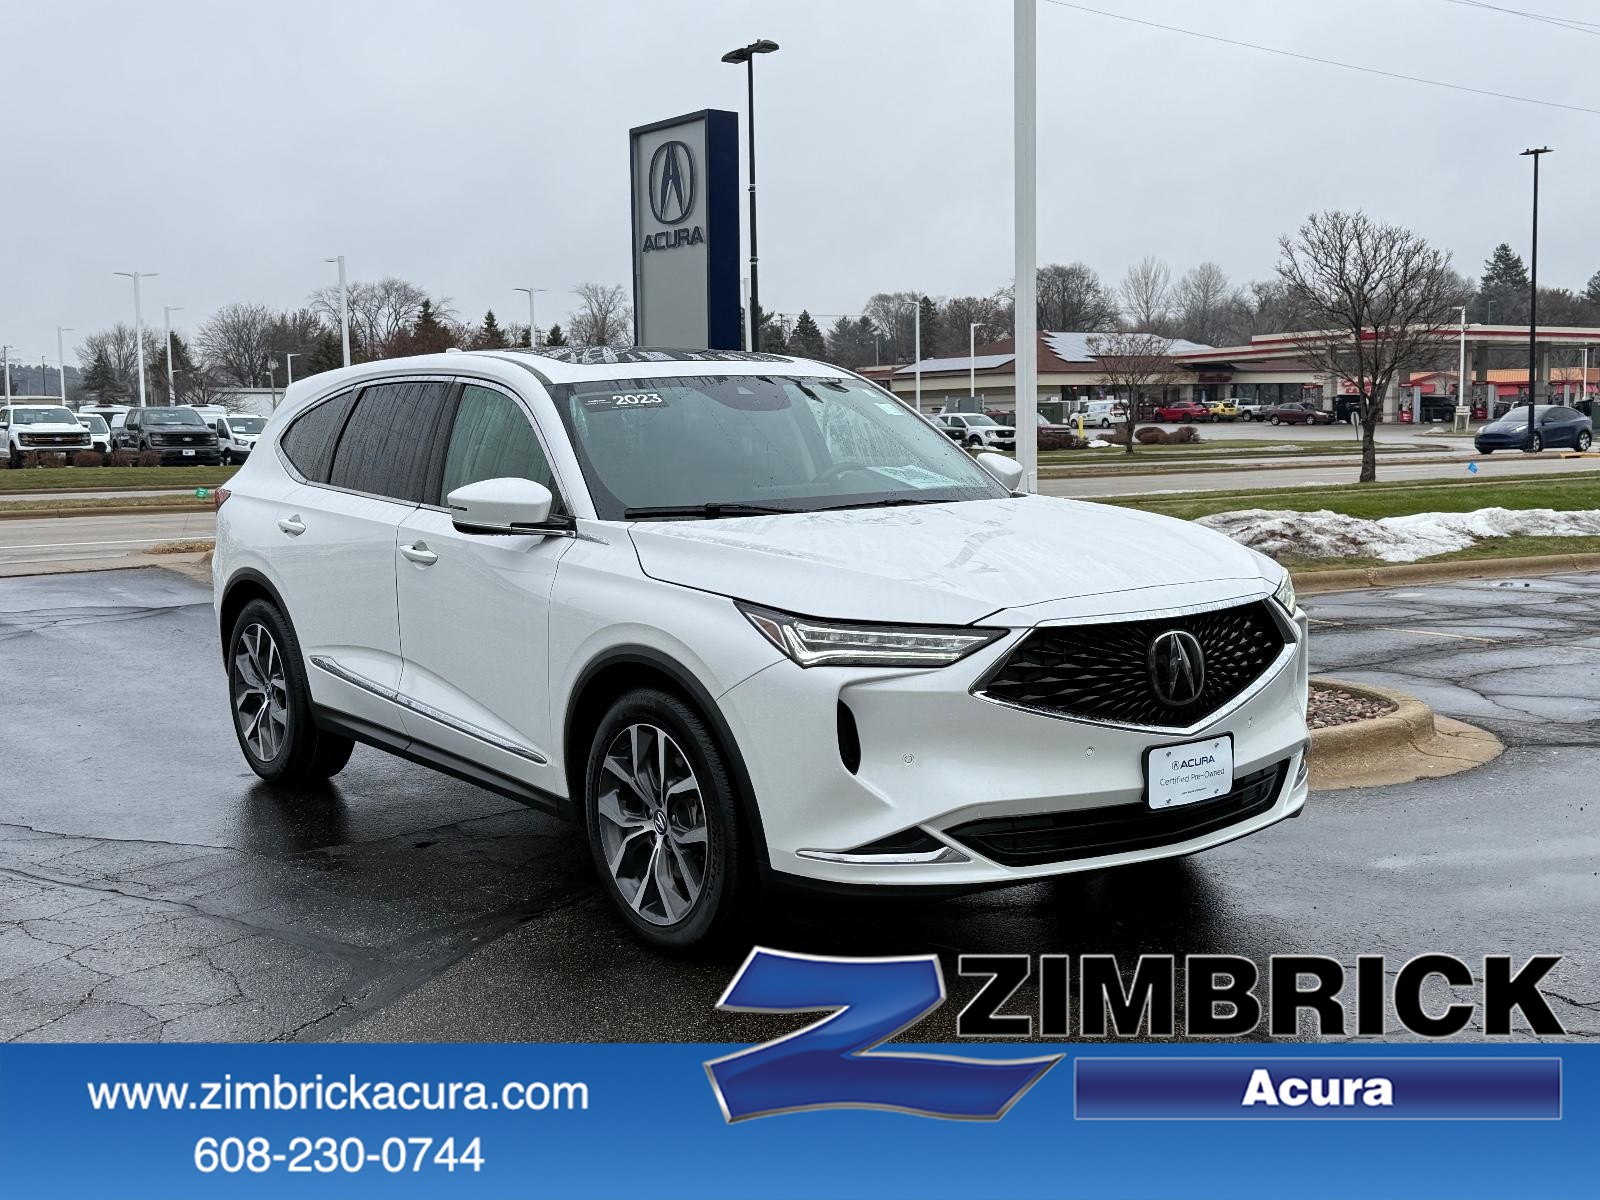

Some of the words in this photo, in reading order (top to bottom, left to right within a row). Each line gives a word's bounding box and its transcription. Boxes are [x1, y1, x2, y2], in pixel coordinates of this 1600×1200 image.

[642, 225, 704, 253] ACURA
[612, 393, 663, 405] 2023
[1180, 755, 1216, 770] ACURA
[1160, 774, 1190, 787] Certified
[1191, 768, 1225, 781] Pre-Owned
